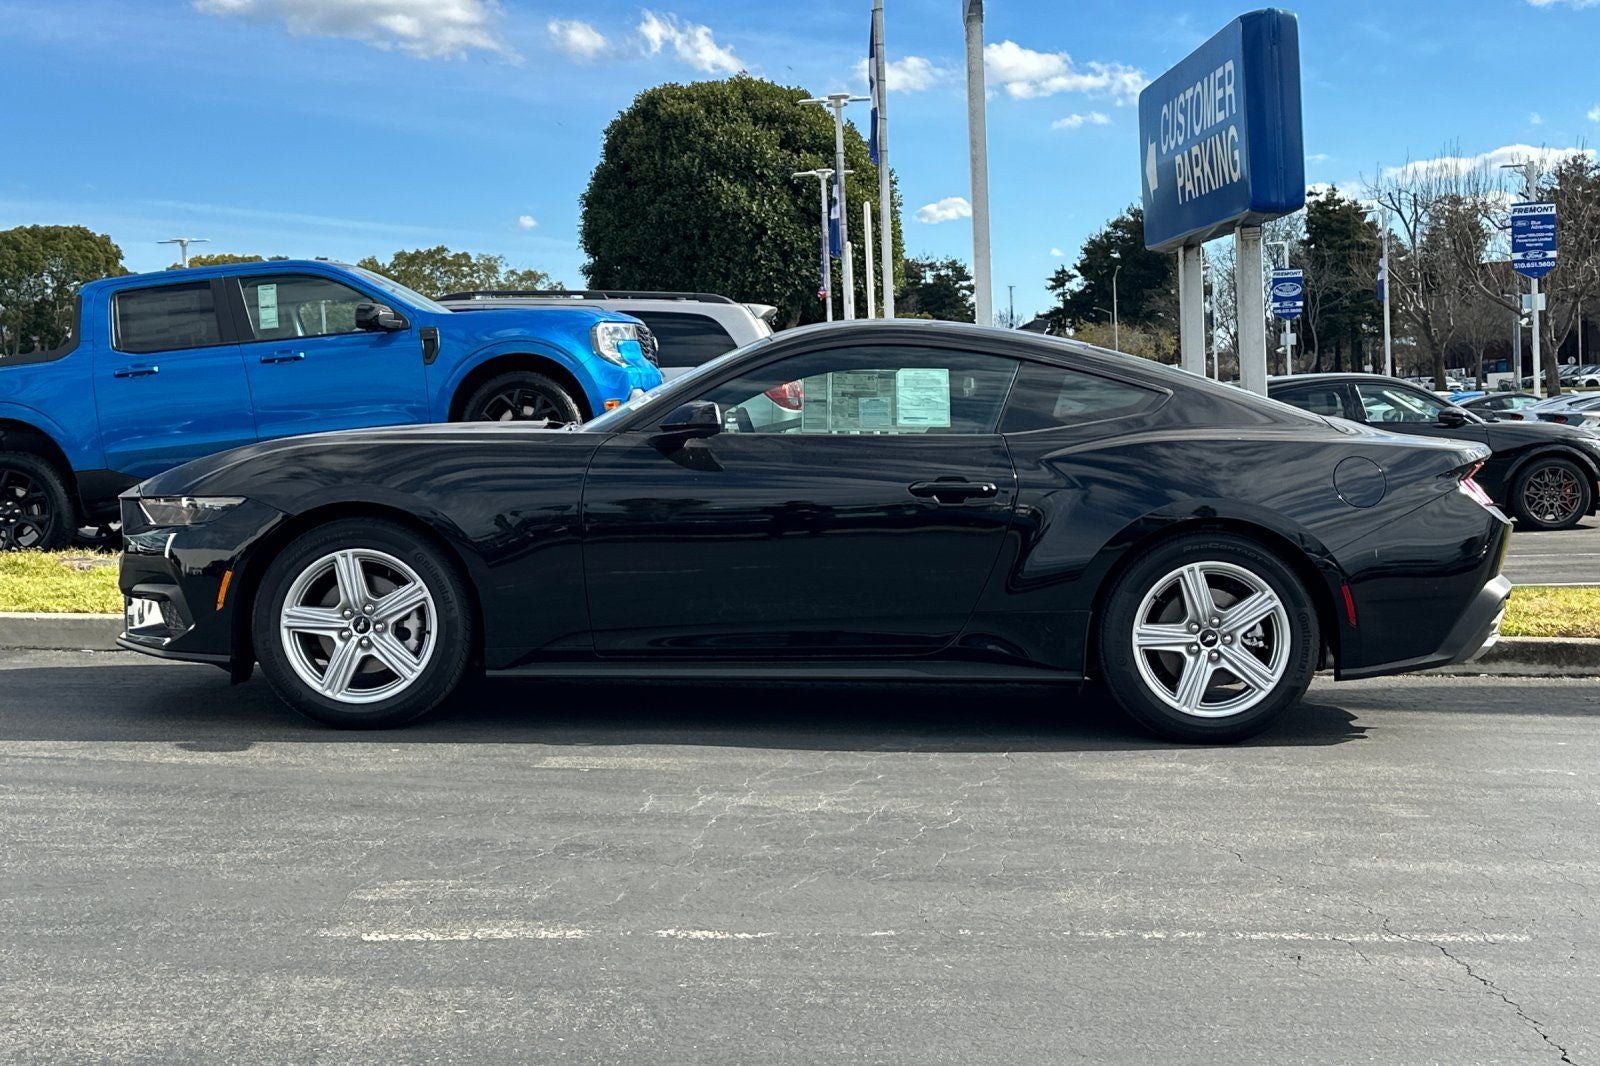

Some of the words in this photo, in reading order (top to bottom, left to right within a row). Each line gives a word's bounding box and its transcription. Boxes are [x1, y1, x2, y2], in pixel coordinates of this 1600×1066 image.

[1161, 59, 1236, 155] CUSTOMER
[1175, 125, 1241, 205] PARKING
[1512, 206, 1554, 214] FREMONT
[414, 551, 454, 606] Continental
[1297, 611, 1314, 673] Continental
